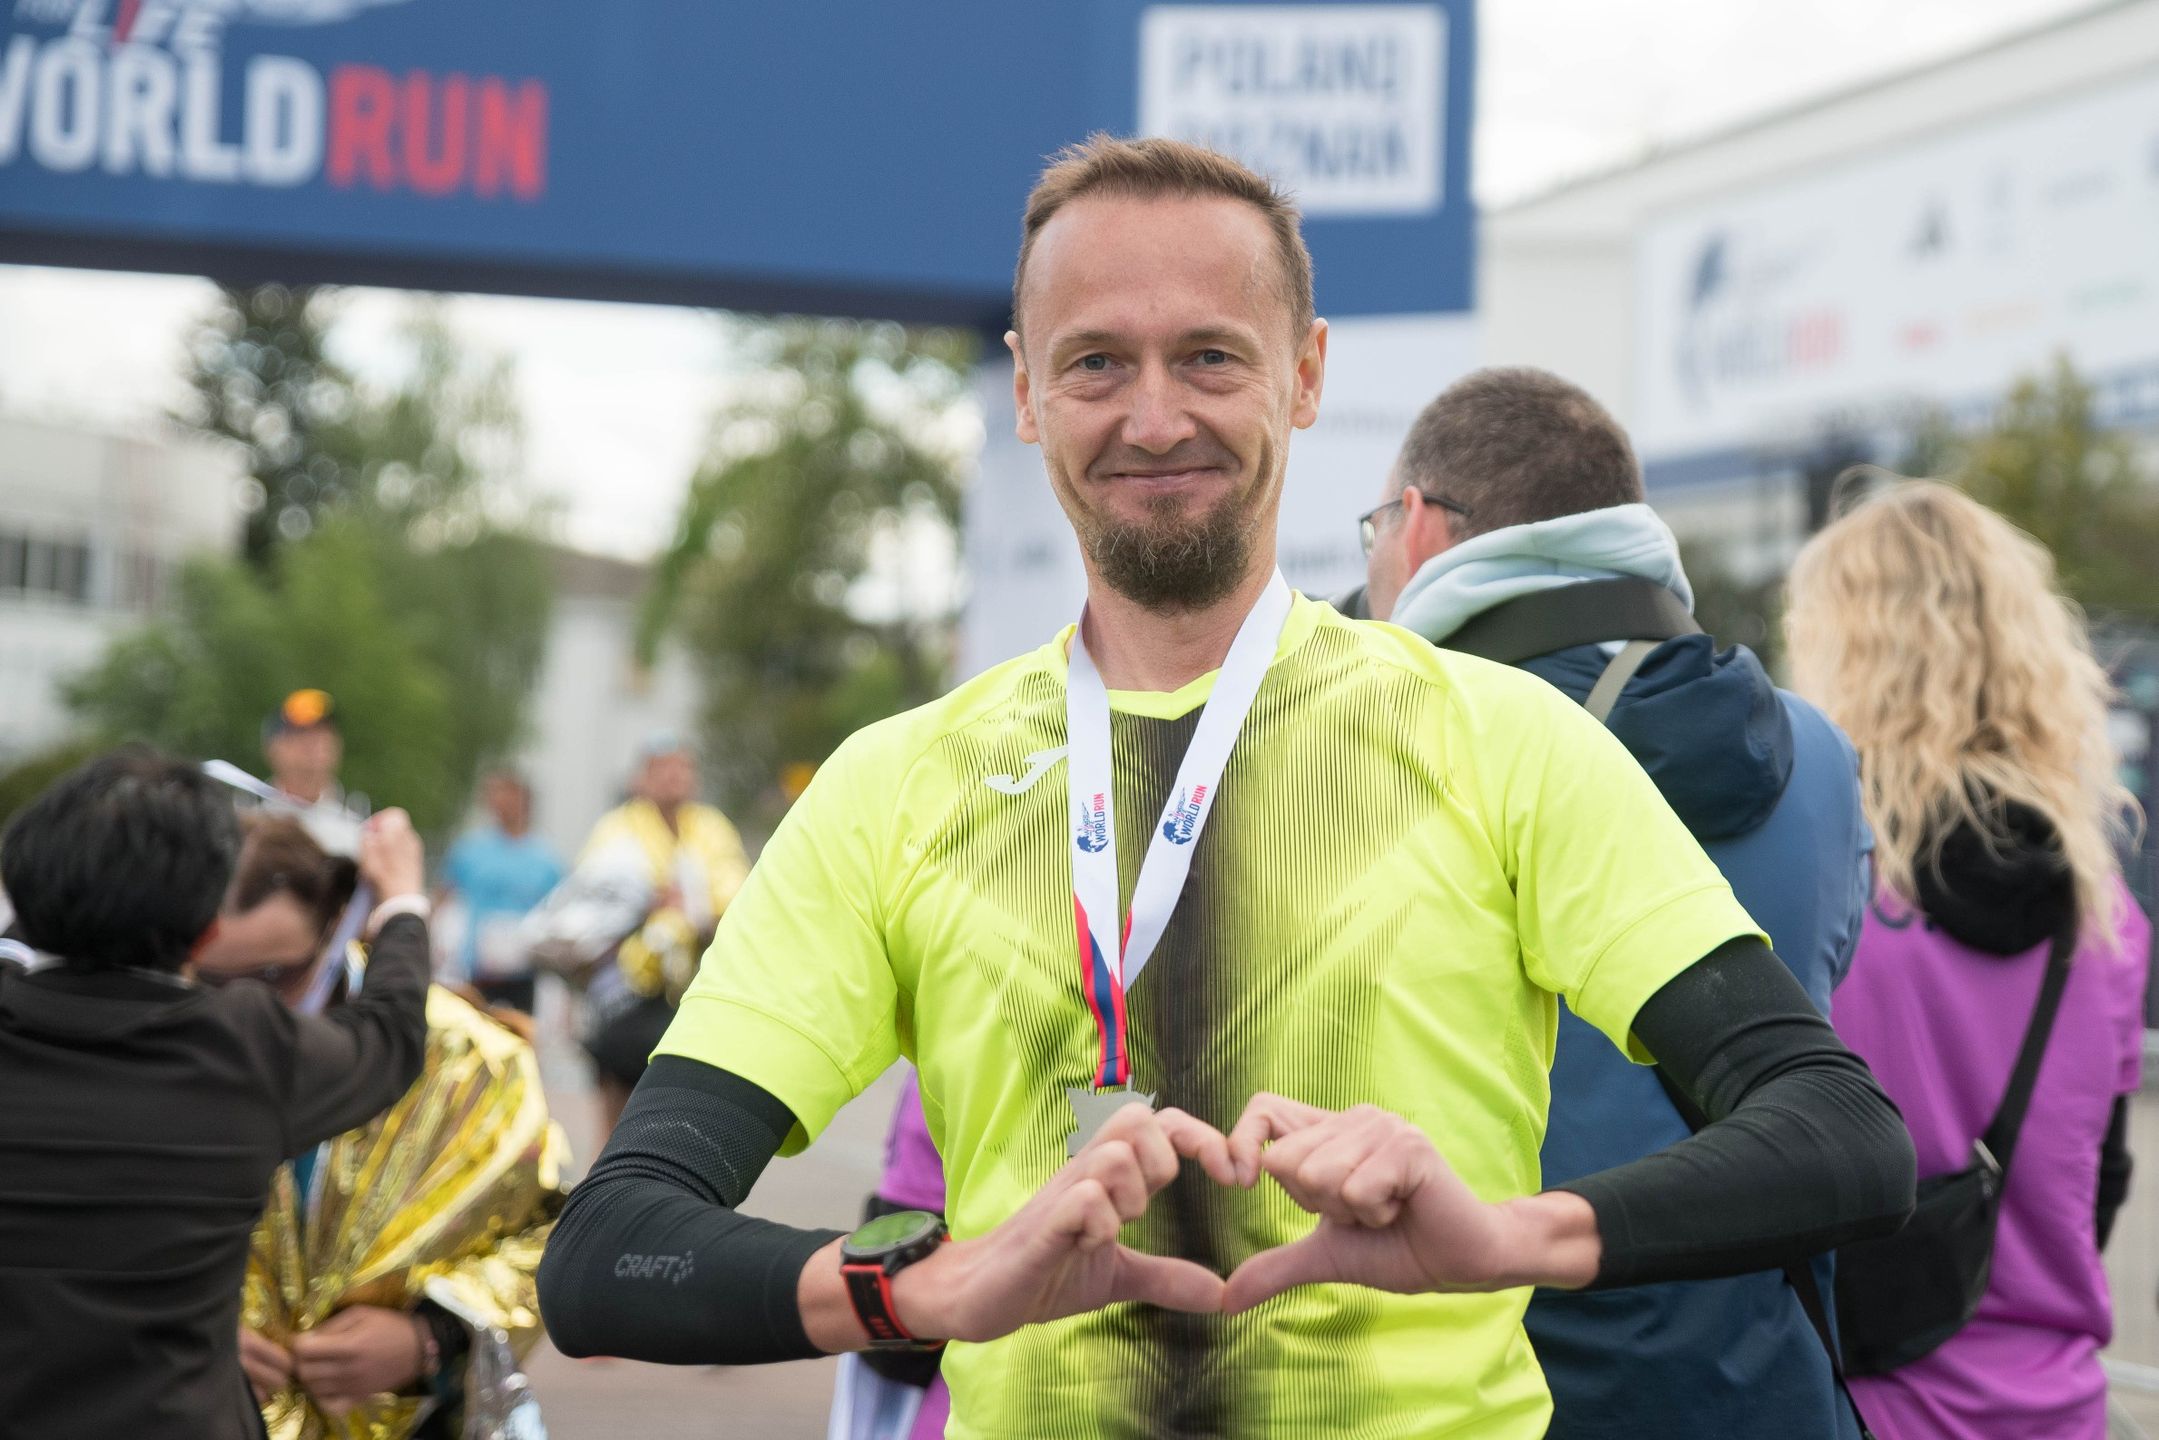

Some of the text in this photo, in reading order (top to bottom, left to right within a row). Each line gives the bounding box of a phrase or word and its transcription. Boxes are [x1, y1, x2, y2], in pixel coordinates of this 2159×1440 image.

[327, 62, 549, 200] RUN
[1093, 792, 1106, 843] WORLD RUN
[1180, 803, 1201, 836] WORLD
[1191, 784, 1208, 805] RUN
[614, 1253, 681, 1278] CRAFT
